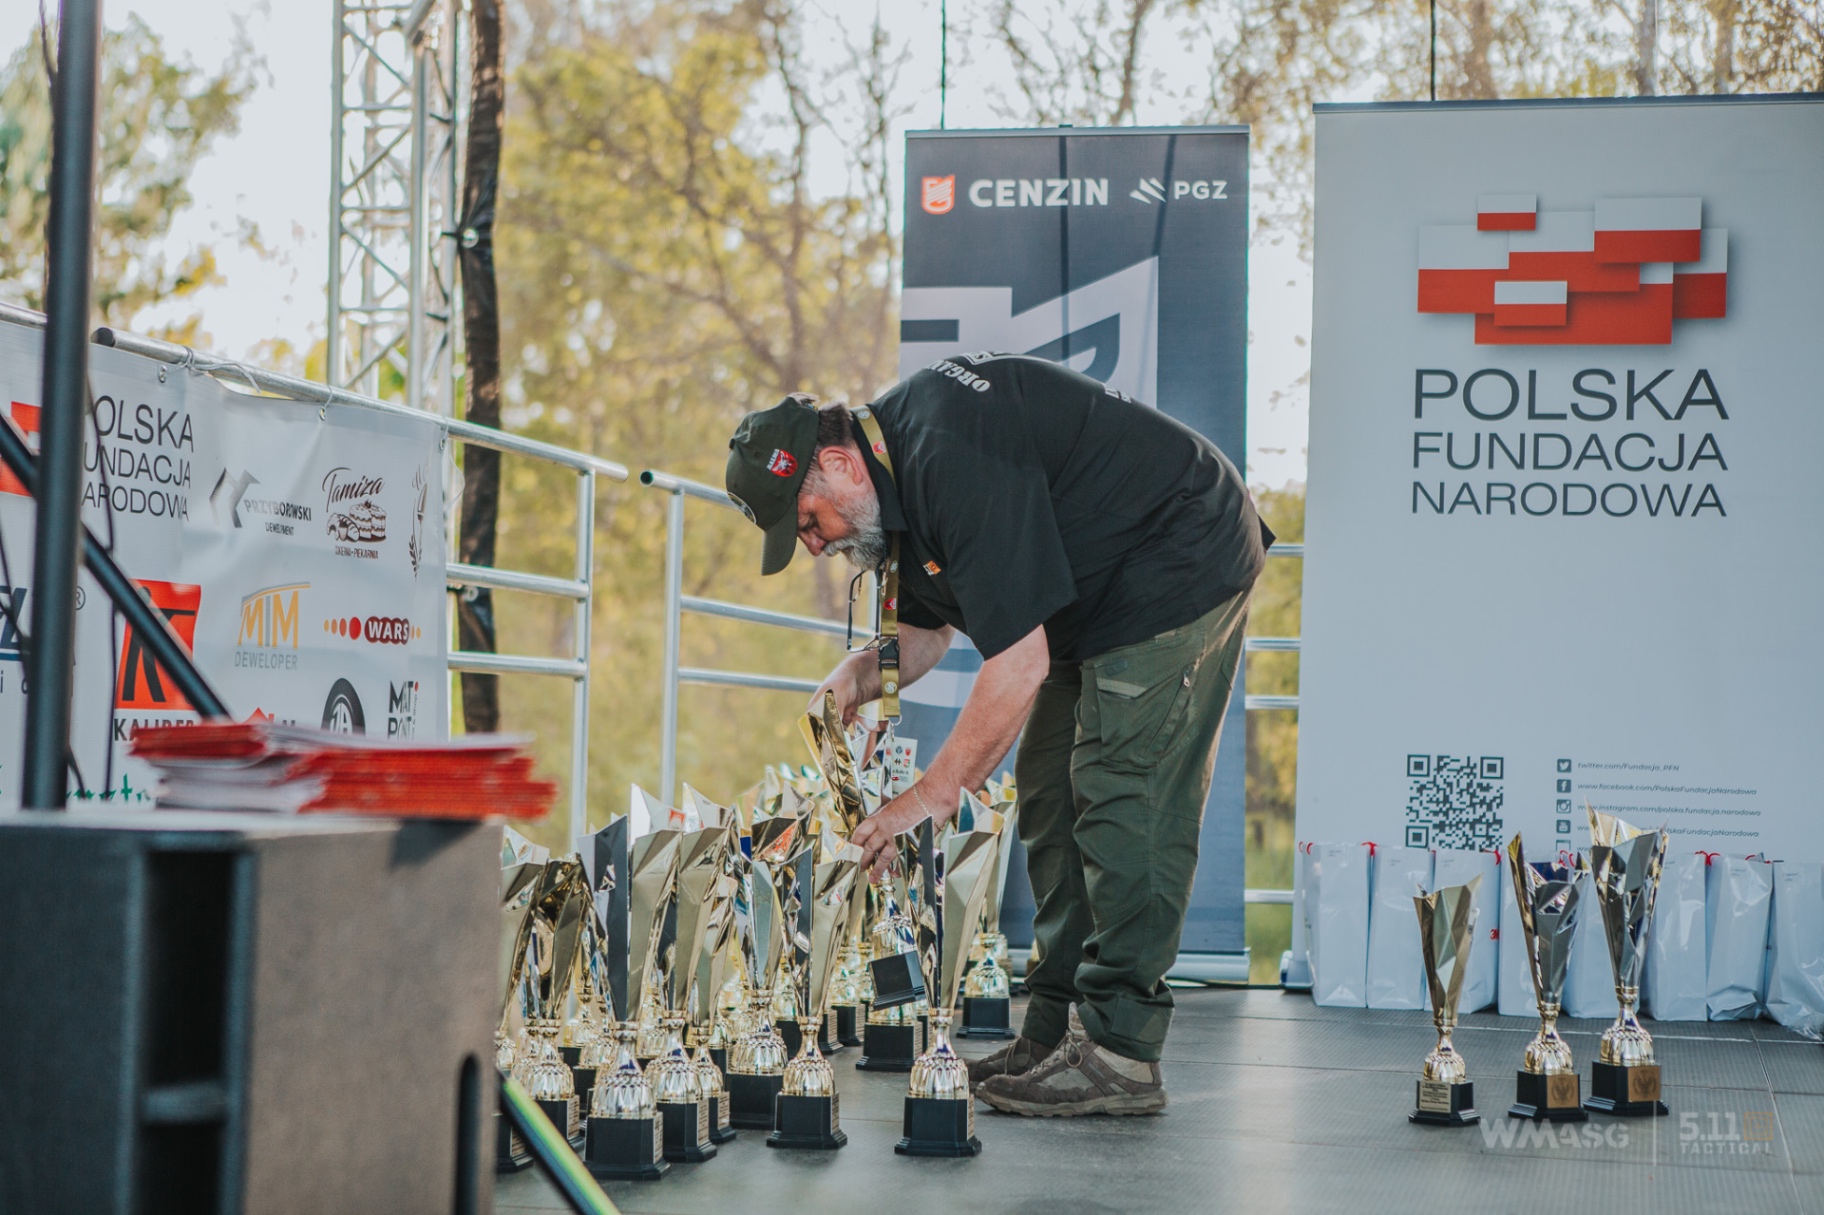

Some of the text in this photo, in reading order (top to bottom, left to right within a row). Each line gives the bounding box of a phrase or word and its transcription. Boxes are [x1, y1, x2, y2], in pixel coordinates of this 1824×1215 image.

[969, 178, 1108, 207] CENZIN
[1174, 181, 1228, 200] PGZ
[1414, 368, 1730, 422] POLSKA
[93, 395, 194, 453] OLSKA
[83, 441, 191, 489] UNDACJA
[1413, 432, 1728, 472] FUNDACJA
[81, 481, 189, 521] ARODOWA
[322, 467, 385, 513] Tamiza
[1412, 481, 1727, 517] NARODOWA
[367, 620, 410, 641] WARS
[234, 650, 298, 670] DEWELOPER
[1577, 762, 1680, 772] twitter.com/Fundacja_PFN
[1577, 783, 1757, 796] www.facebook.com/PolskaFundacjaNarodowa
